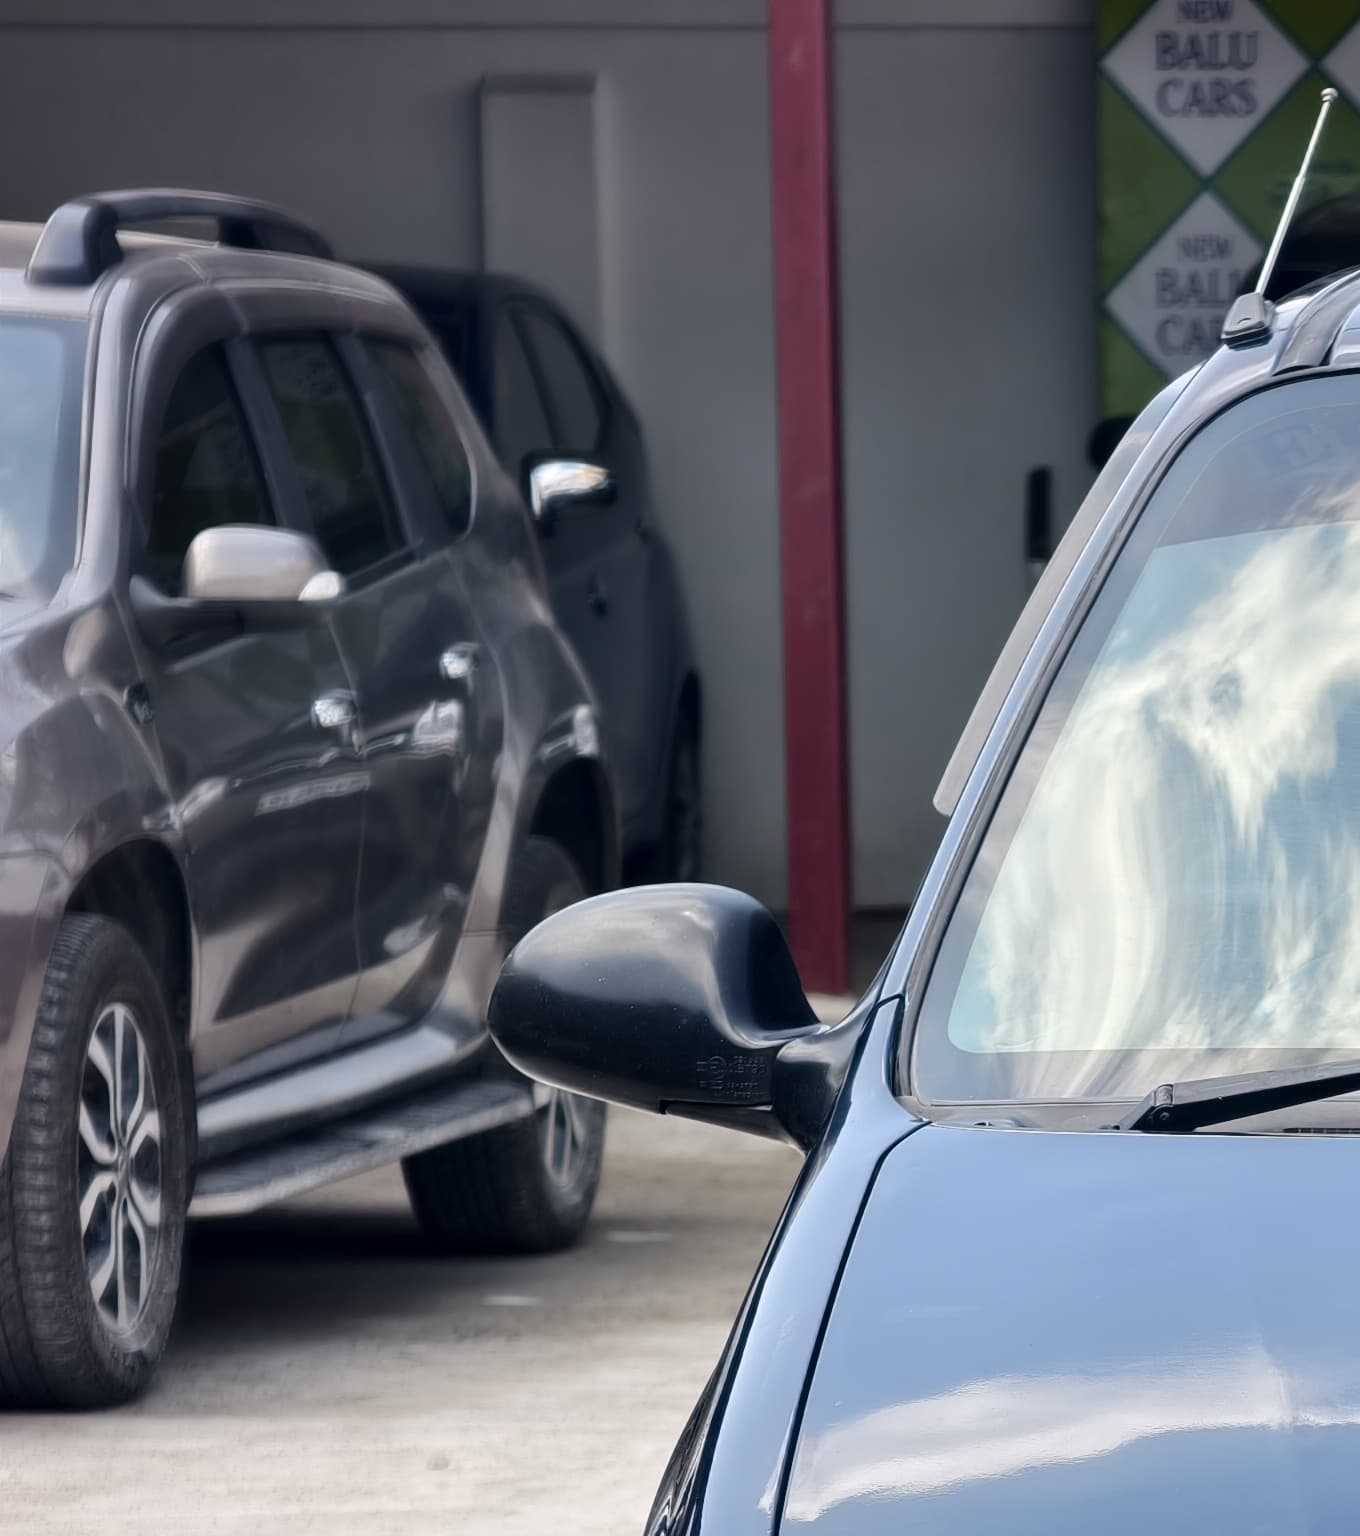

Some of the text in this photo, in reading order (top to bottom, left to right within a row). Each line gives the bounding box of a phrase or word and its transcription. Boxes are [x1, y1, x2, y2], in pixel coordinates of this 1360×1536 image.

[1177, 0, 1232, 22] NEW
[1155, 31, 1258, 70] BALU
[1155, 78, 1257, 117] CARS
[1178, 234, 1231, 261] NEW
